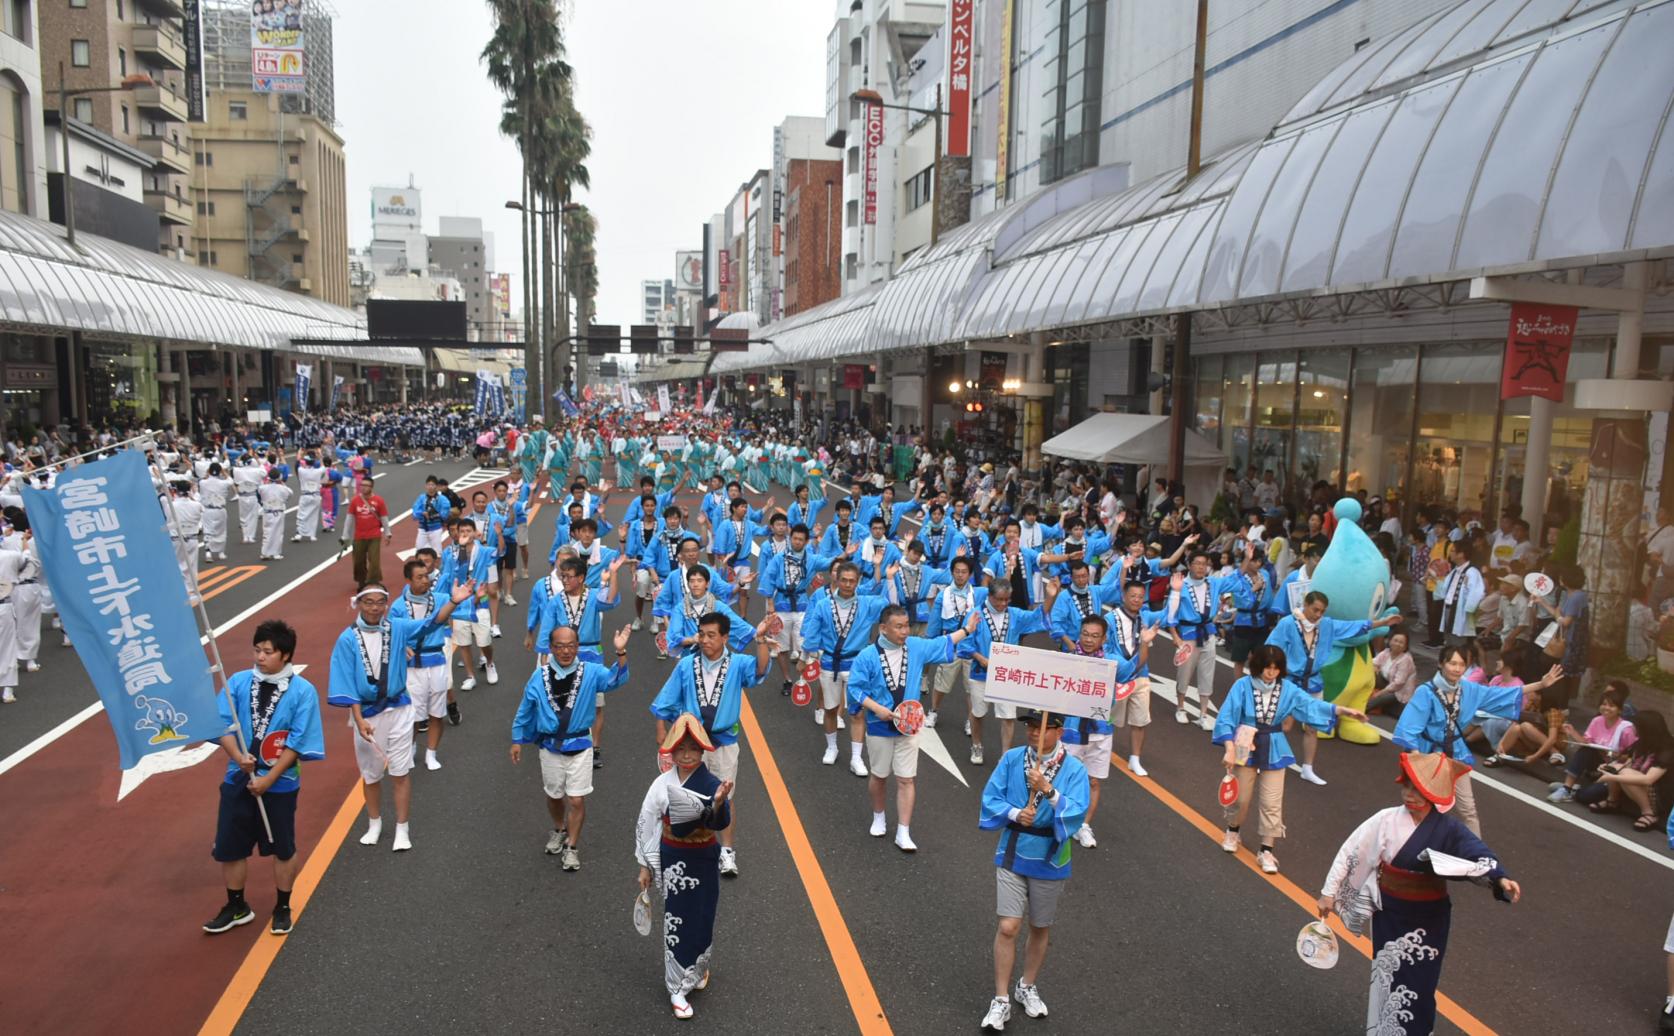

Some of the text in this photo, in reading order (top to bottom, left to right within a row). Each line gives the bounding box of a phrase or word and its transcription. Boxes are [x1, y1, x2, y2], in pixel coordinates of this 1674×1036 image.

[994, 666, 1107, 698] 宮崎市上下水道局
